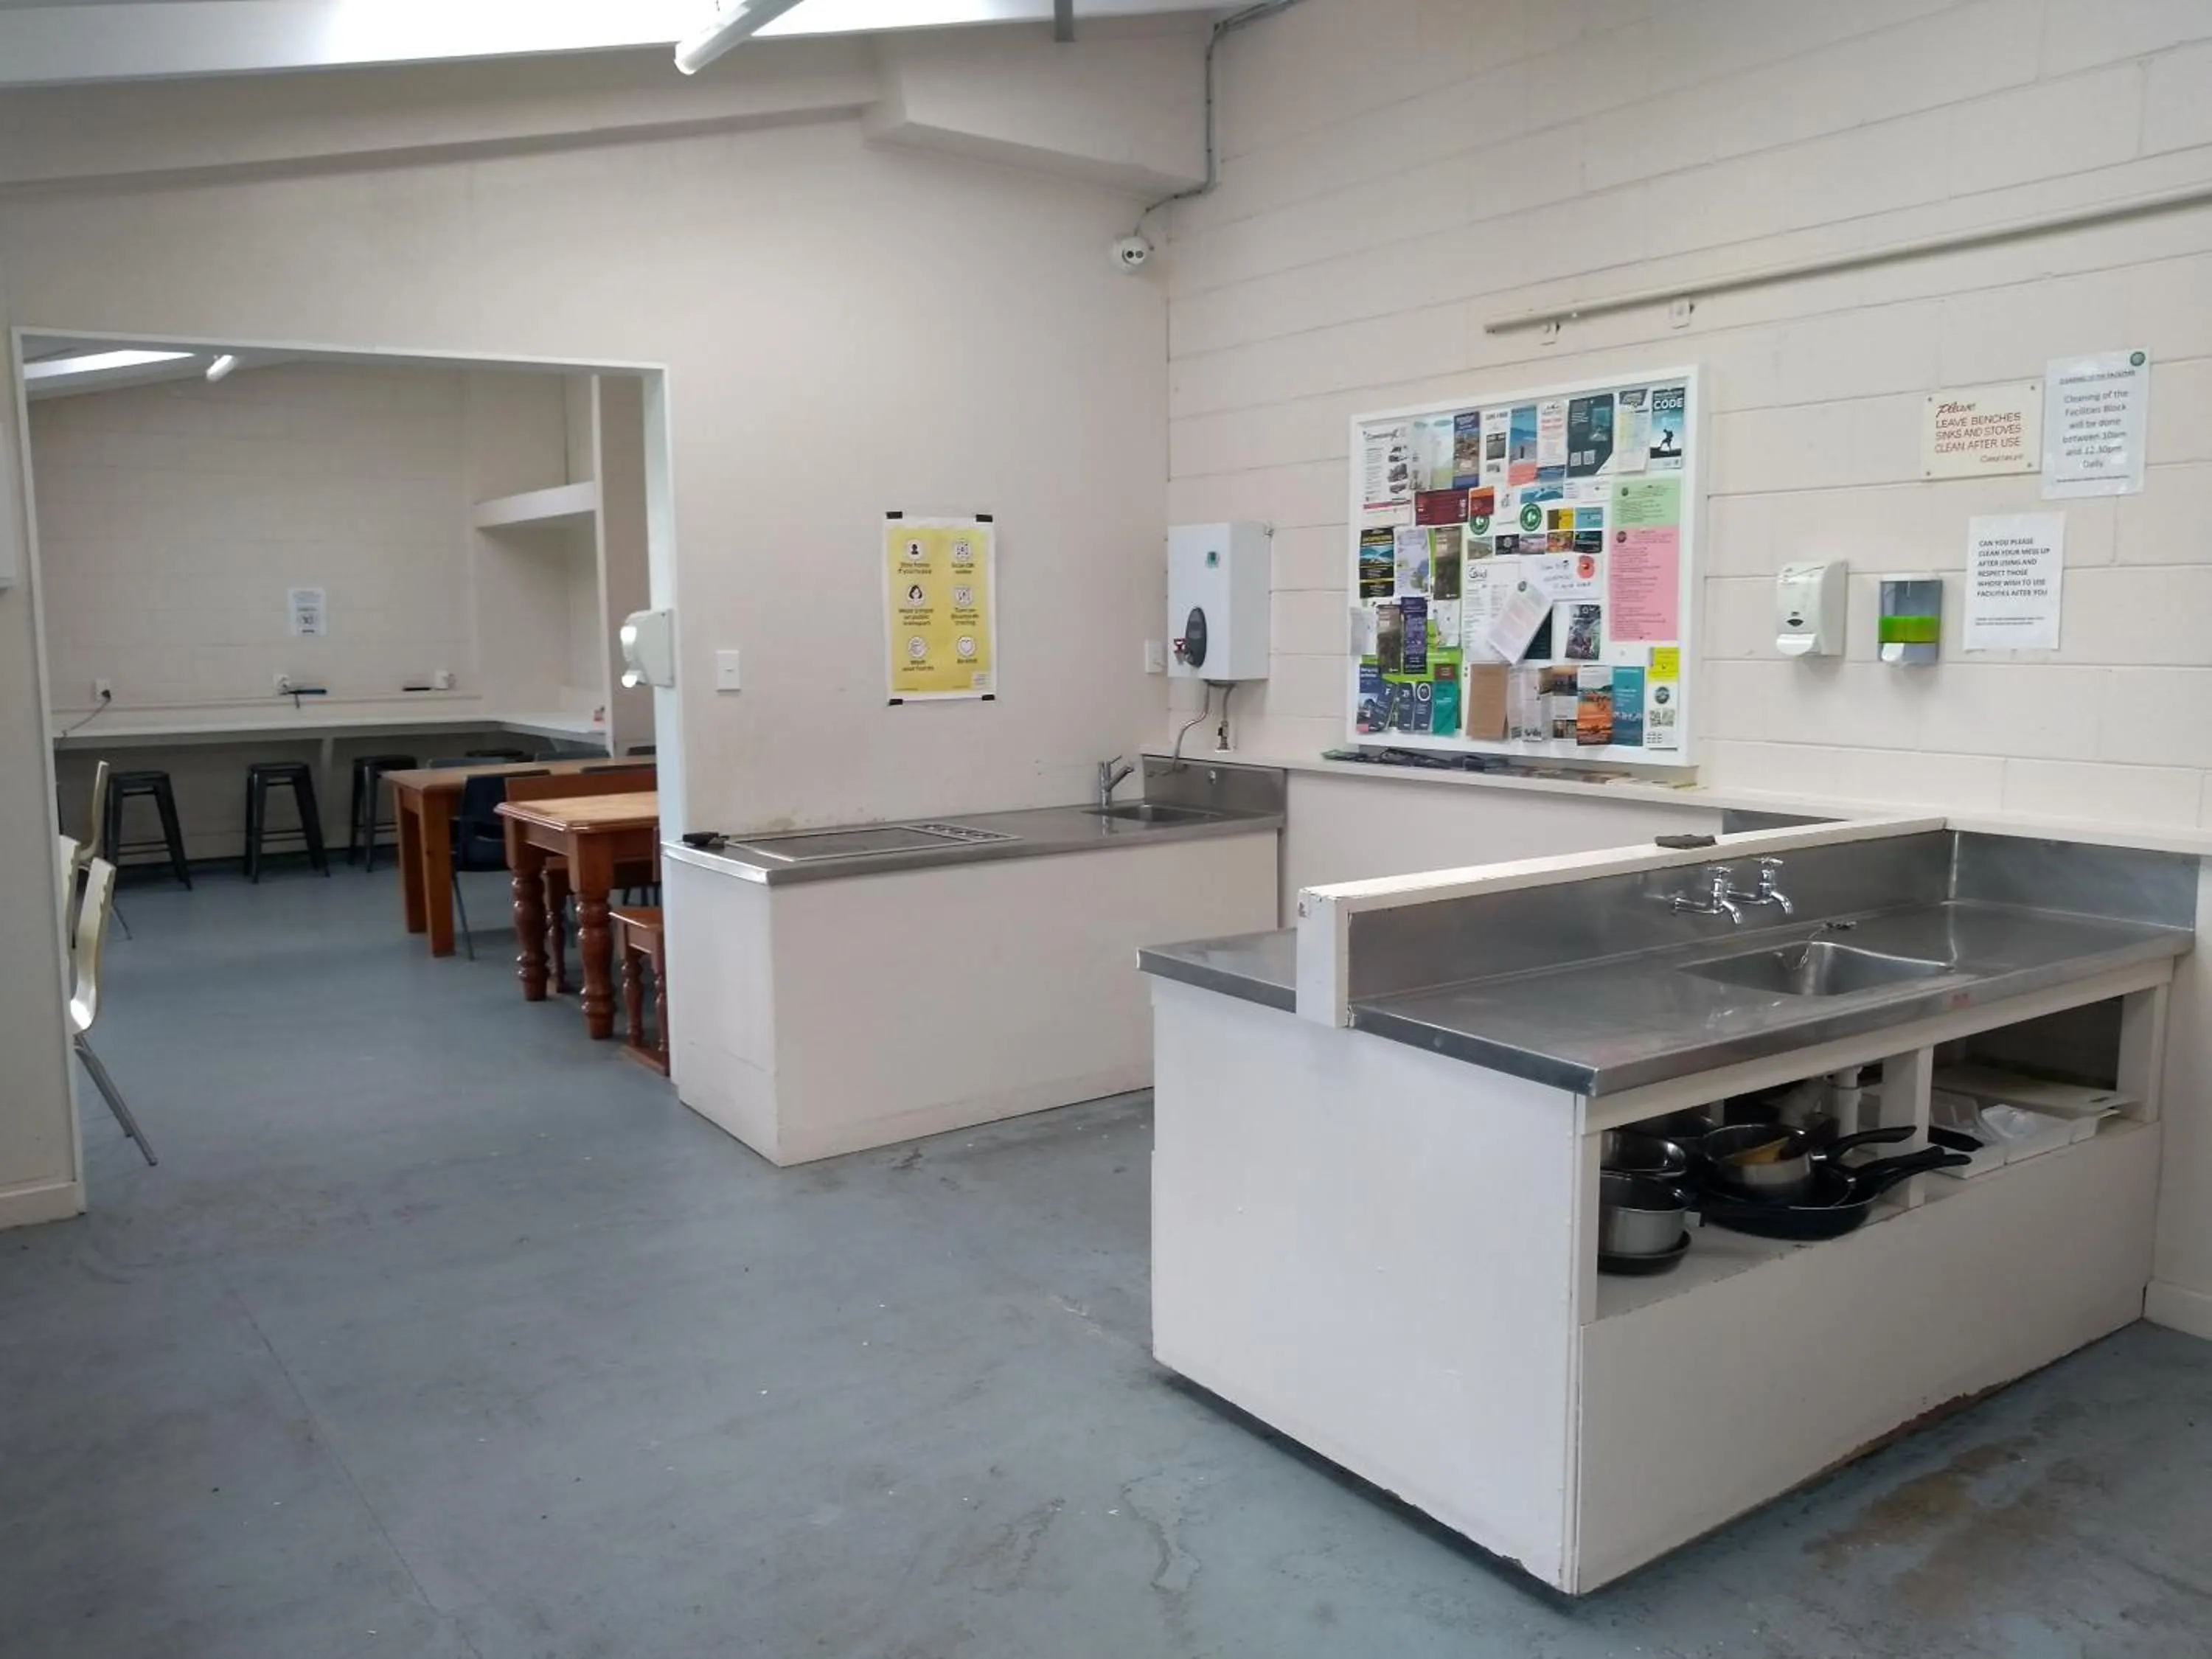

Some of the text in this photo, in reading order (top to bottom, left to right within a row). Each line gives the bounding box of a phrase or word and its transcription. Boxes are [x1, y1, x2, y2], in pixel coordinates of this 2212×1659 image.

[2064, 389, 2129, 404] Cleaning of the
[1654, 397, 1683, 409] CODE
[2065, 403, 2126, 417] Facilities Block
[1935, 412, 2021, 429] LEAVE BENCHES
[2069, 418, 2122, 430] will be done
[1935, 424, 2022, 441] SINKS AND STOVES
[2063, 433, 2099, 443] between
[1935, 437, 2021, 453] CLEAN AFTER USE
[2065, 448, 2082, 456] and
[2082, 460, 2104, 468] Daily
[2011, 538, 2034, 546] PLEASE
[2033, 578, 2046, 586] USE
[2033, 588, 2048, 597] YOU
